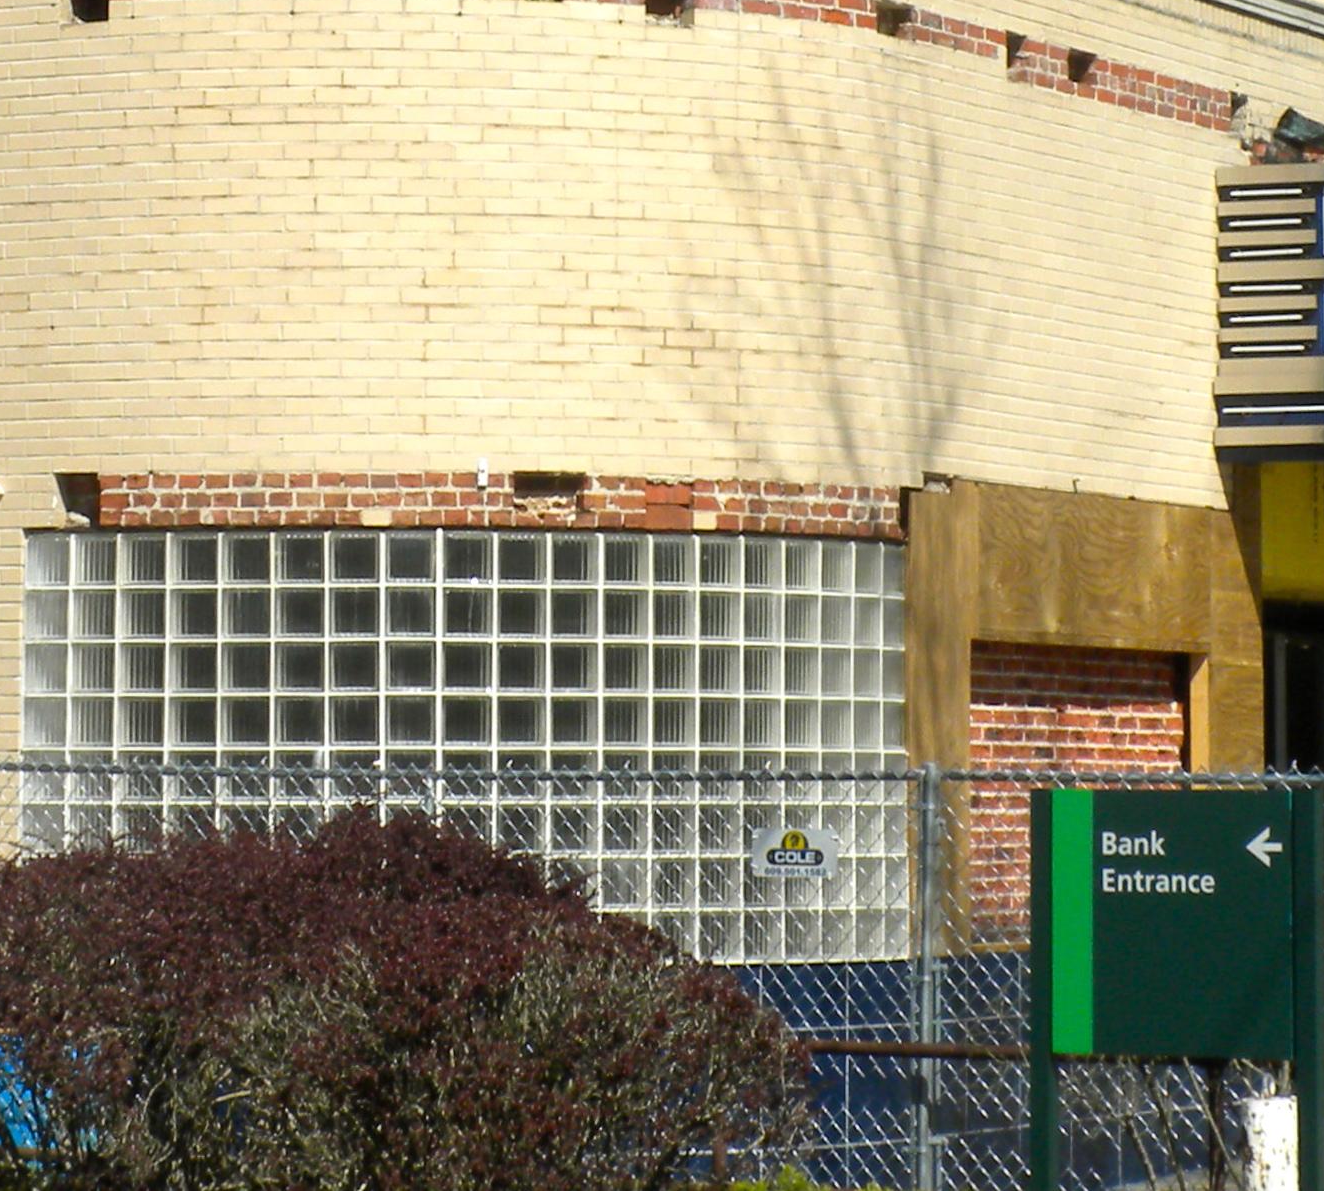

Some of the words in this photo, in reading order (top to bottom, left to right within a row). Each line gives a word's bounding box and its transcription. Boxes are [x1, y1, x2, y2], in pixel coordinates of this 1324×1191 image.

[773, 850, 817, 864] COLE
[1101, 830, 1167, 857] Bank
[1100, 867, 1217, 894] Entrance
